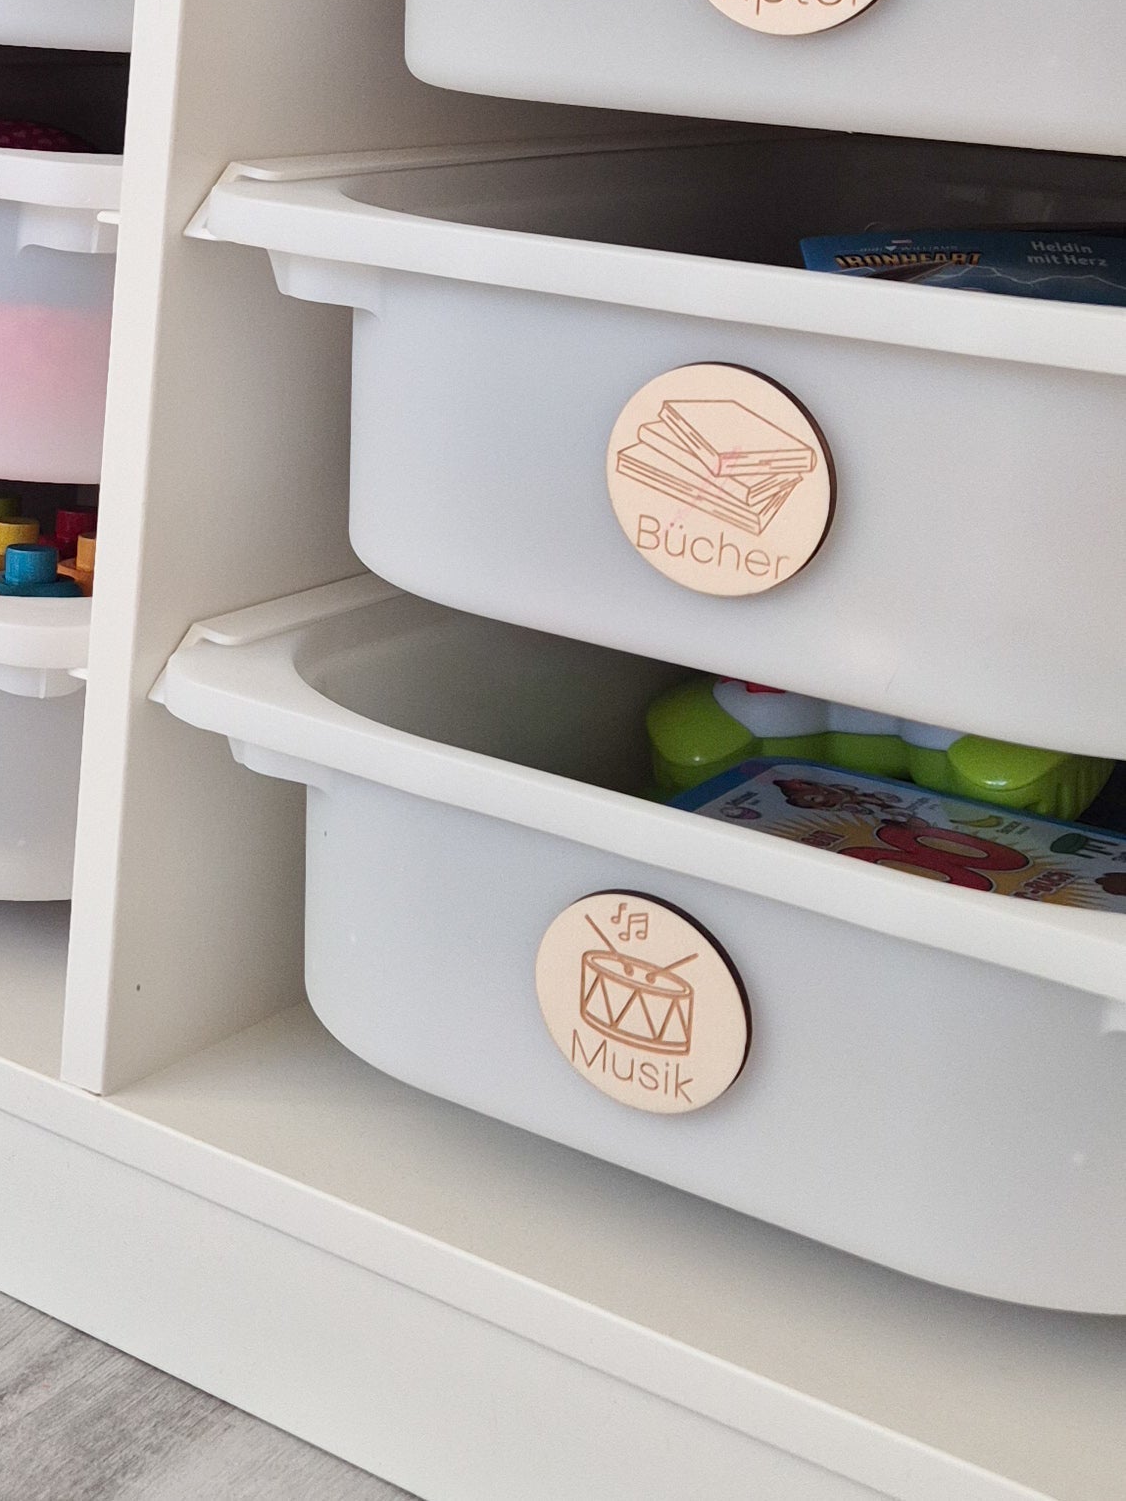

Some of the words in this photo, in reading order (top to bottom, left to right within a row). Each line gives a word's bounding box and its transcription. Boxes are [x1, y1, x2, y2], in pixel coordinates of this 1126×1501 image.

[1030, 240, 1093, 254] Heldin
[835, 251, 982, 268] IRONHEART
[1027, 253, 1061, 265] mit
[1063, 255, 1108, 267] Herz
[636, 514, 790, 580] Bücher
[571, 1028, 694, 1104] Musik
